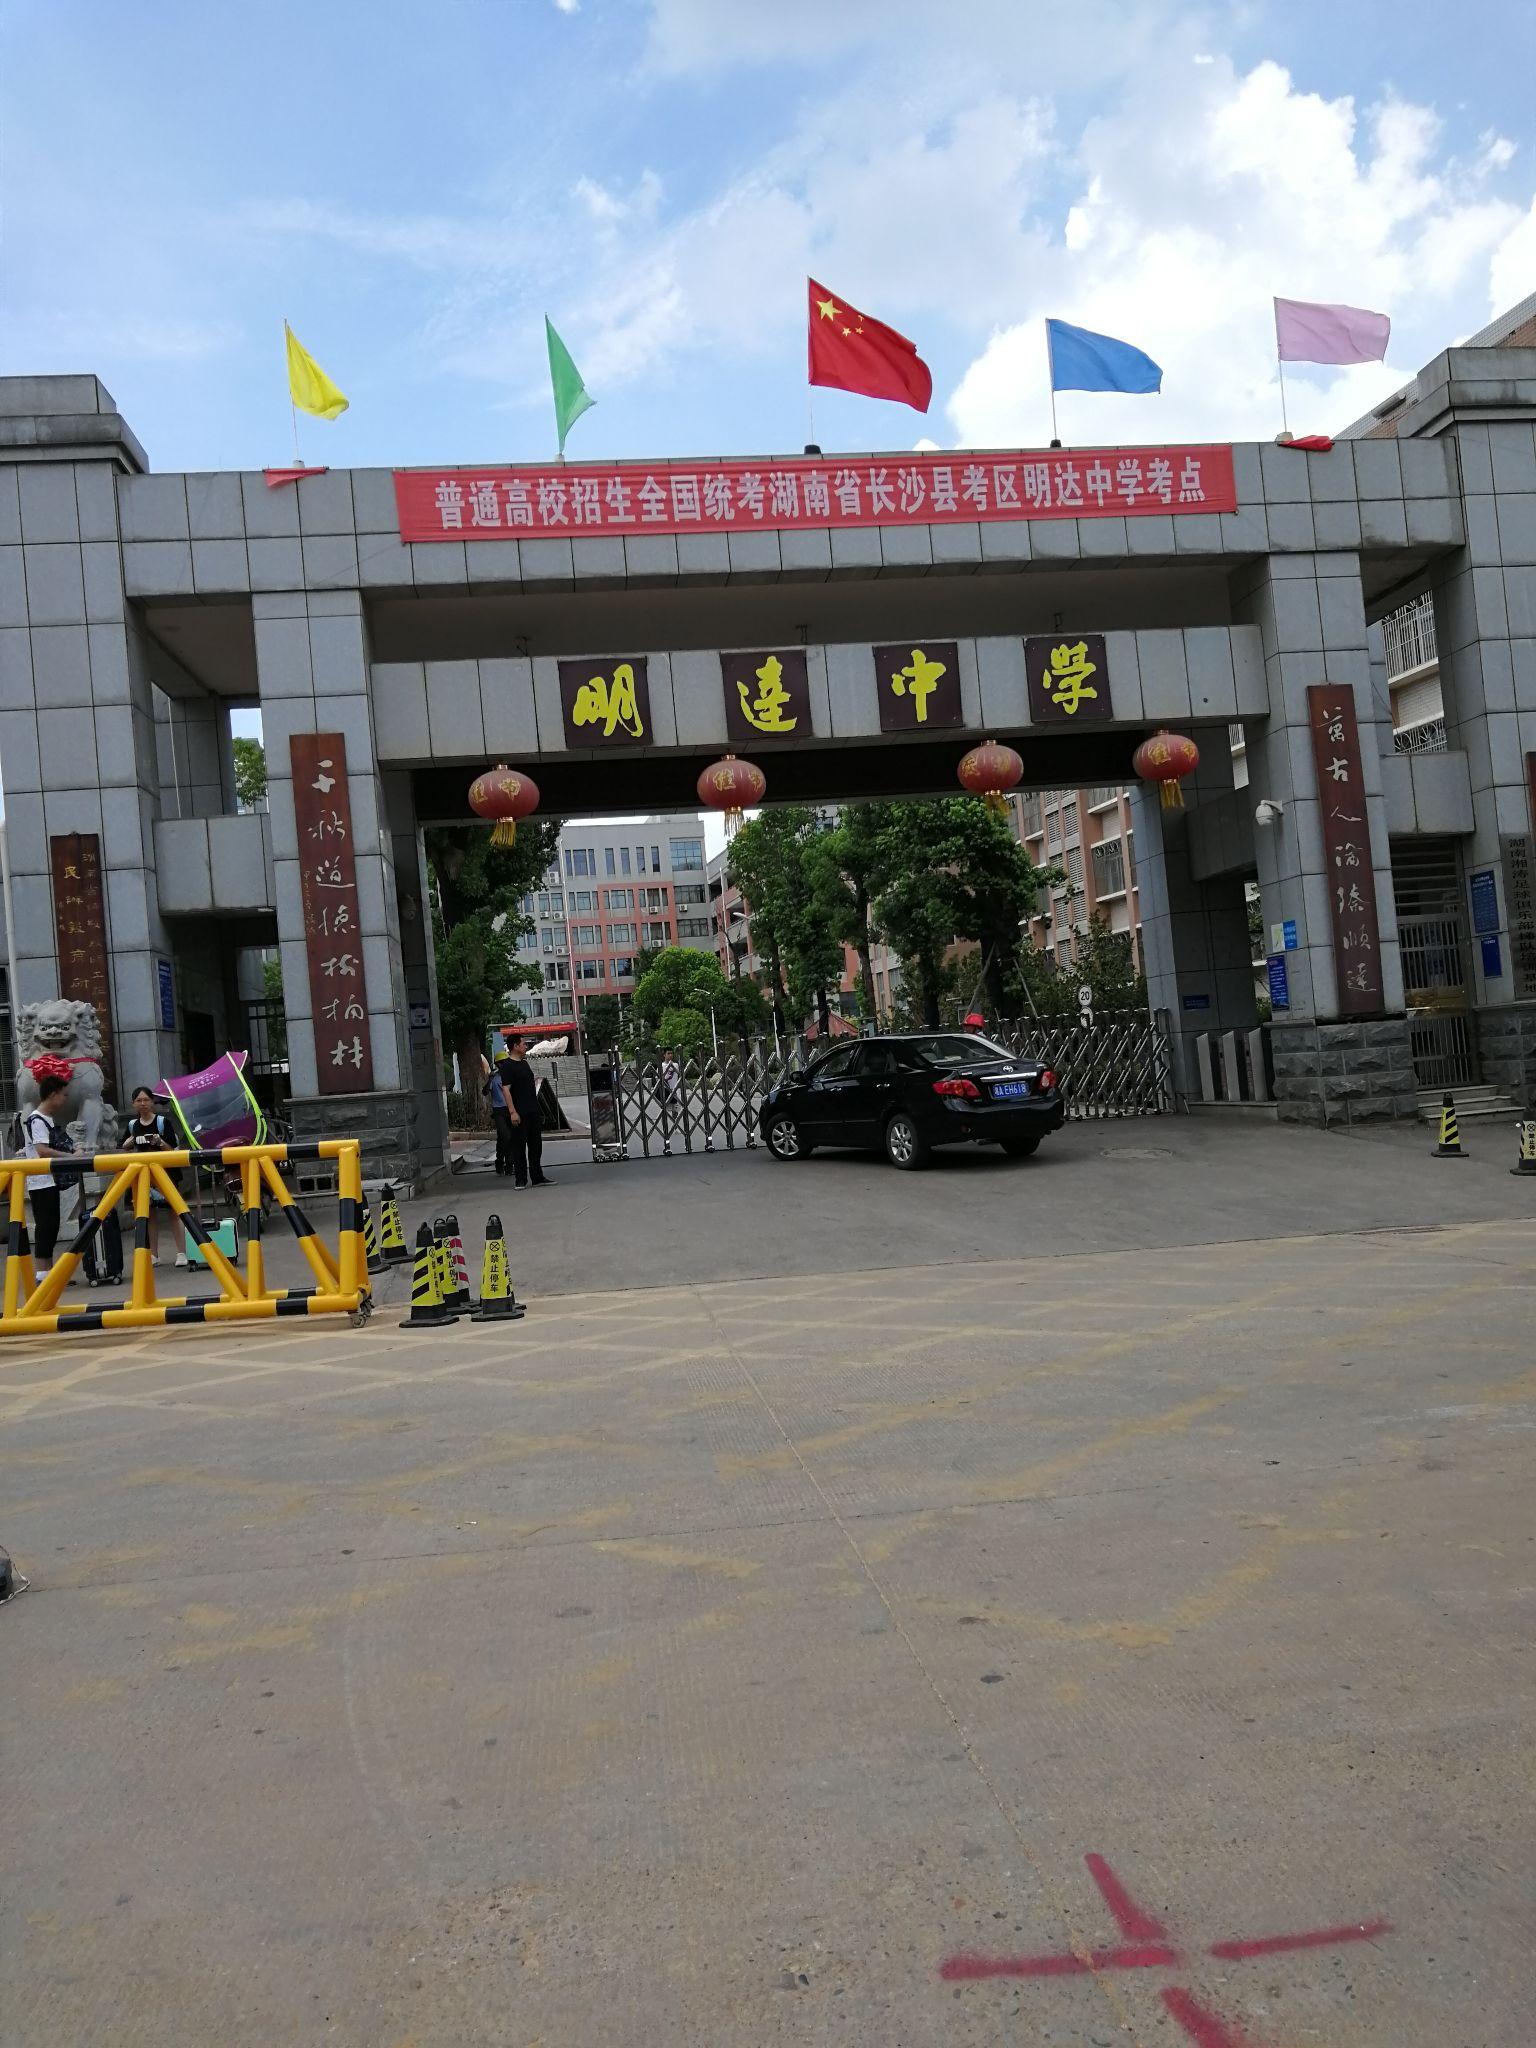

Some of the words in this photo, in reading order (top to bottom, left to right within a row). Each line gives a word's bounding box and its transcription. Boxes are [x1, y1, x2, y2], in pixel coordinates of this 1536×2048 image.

[435, 456, 1205, 529] 普通高校招生全国统考湖南省长沙县考区明达中学考点
[1080, 991, 1090, 1001] 20
[490, 1254, 500, 1293] 禁止停车
